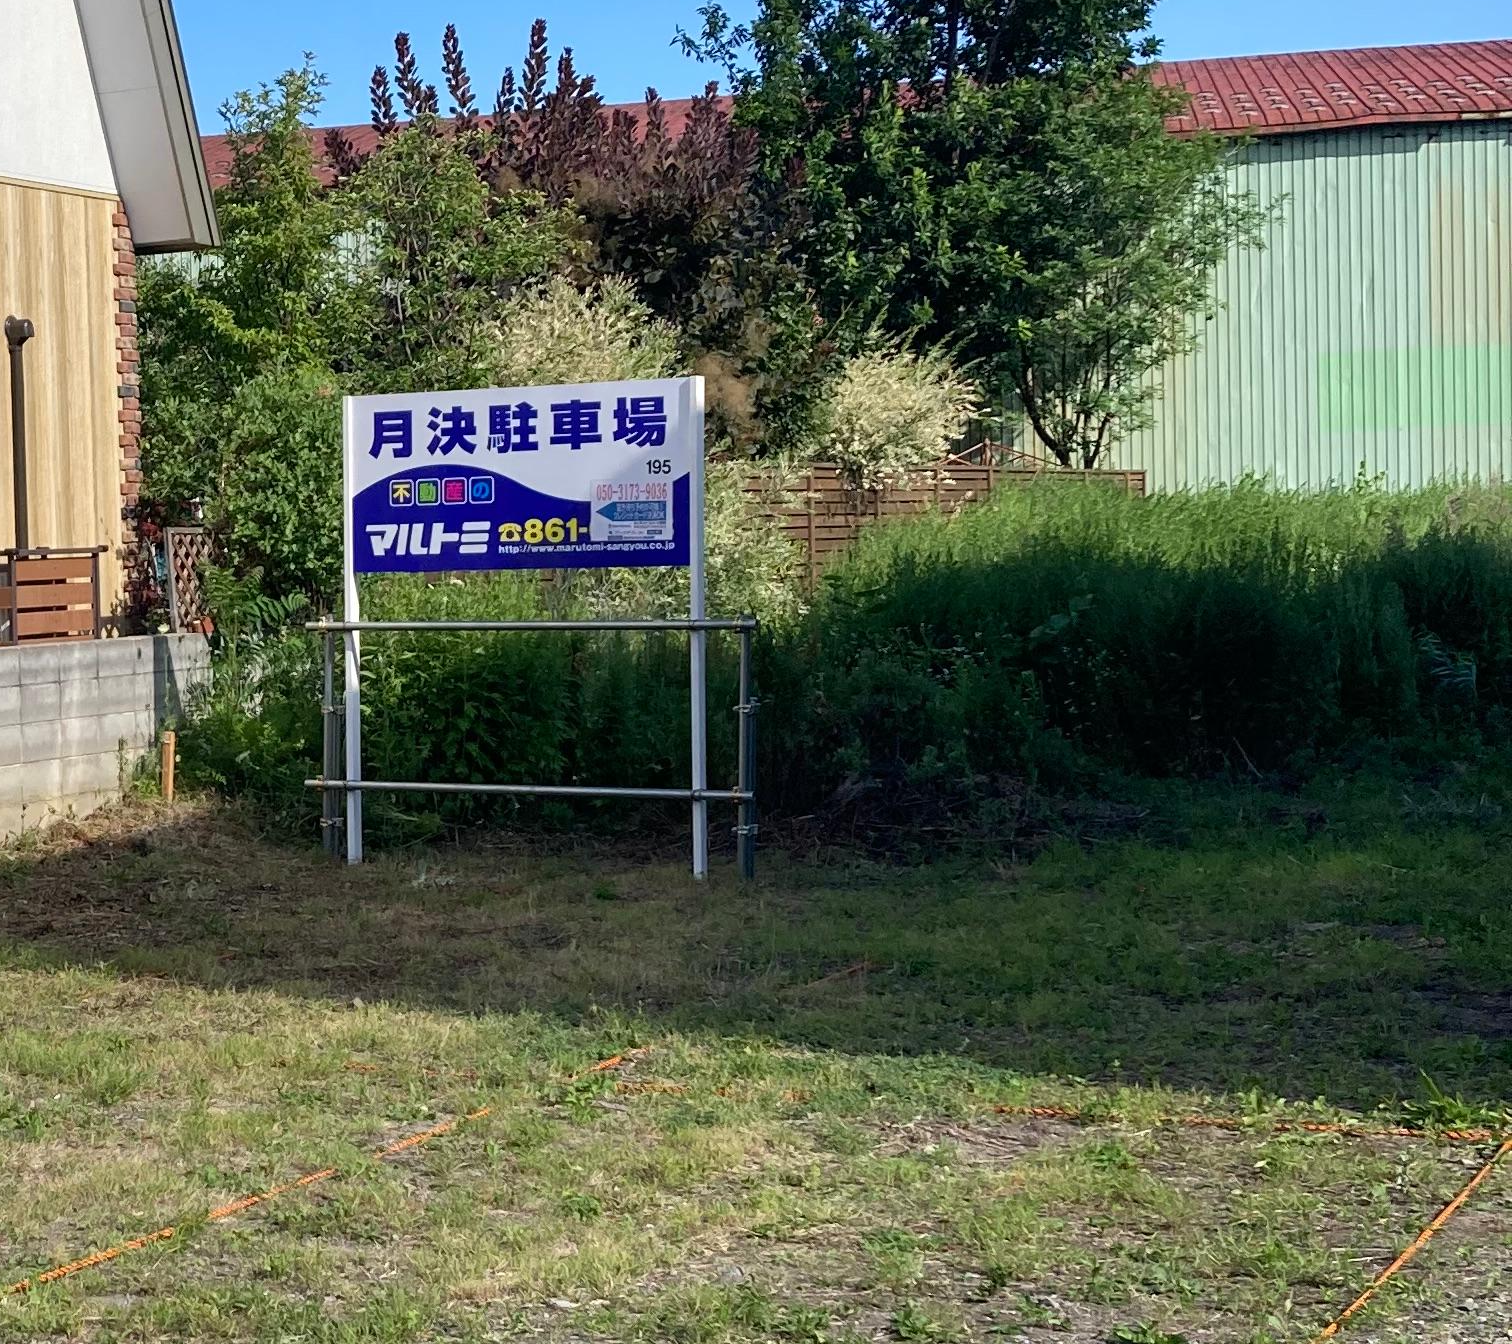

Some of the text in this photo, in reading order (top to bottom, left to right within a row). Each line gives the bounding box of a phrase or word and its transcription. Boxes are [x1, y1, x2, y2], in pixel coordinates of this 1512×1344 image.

[368, 396, 667, 459] 月決駐車場
[645, 459, 672, 475] 195
[392, 481, 491, 504] 不動産の
[365, 520, 491, 556] マルトミ
[498, 541, 676, 554] http://www.marutomi-sangyou.co.jp
